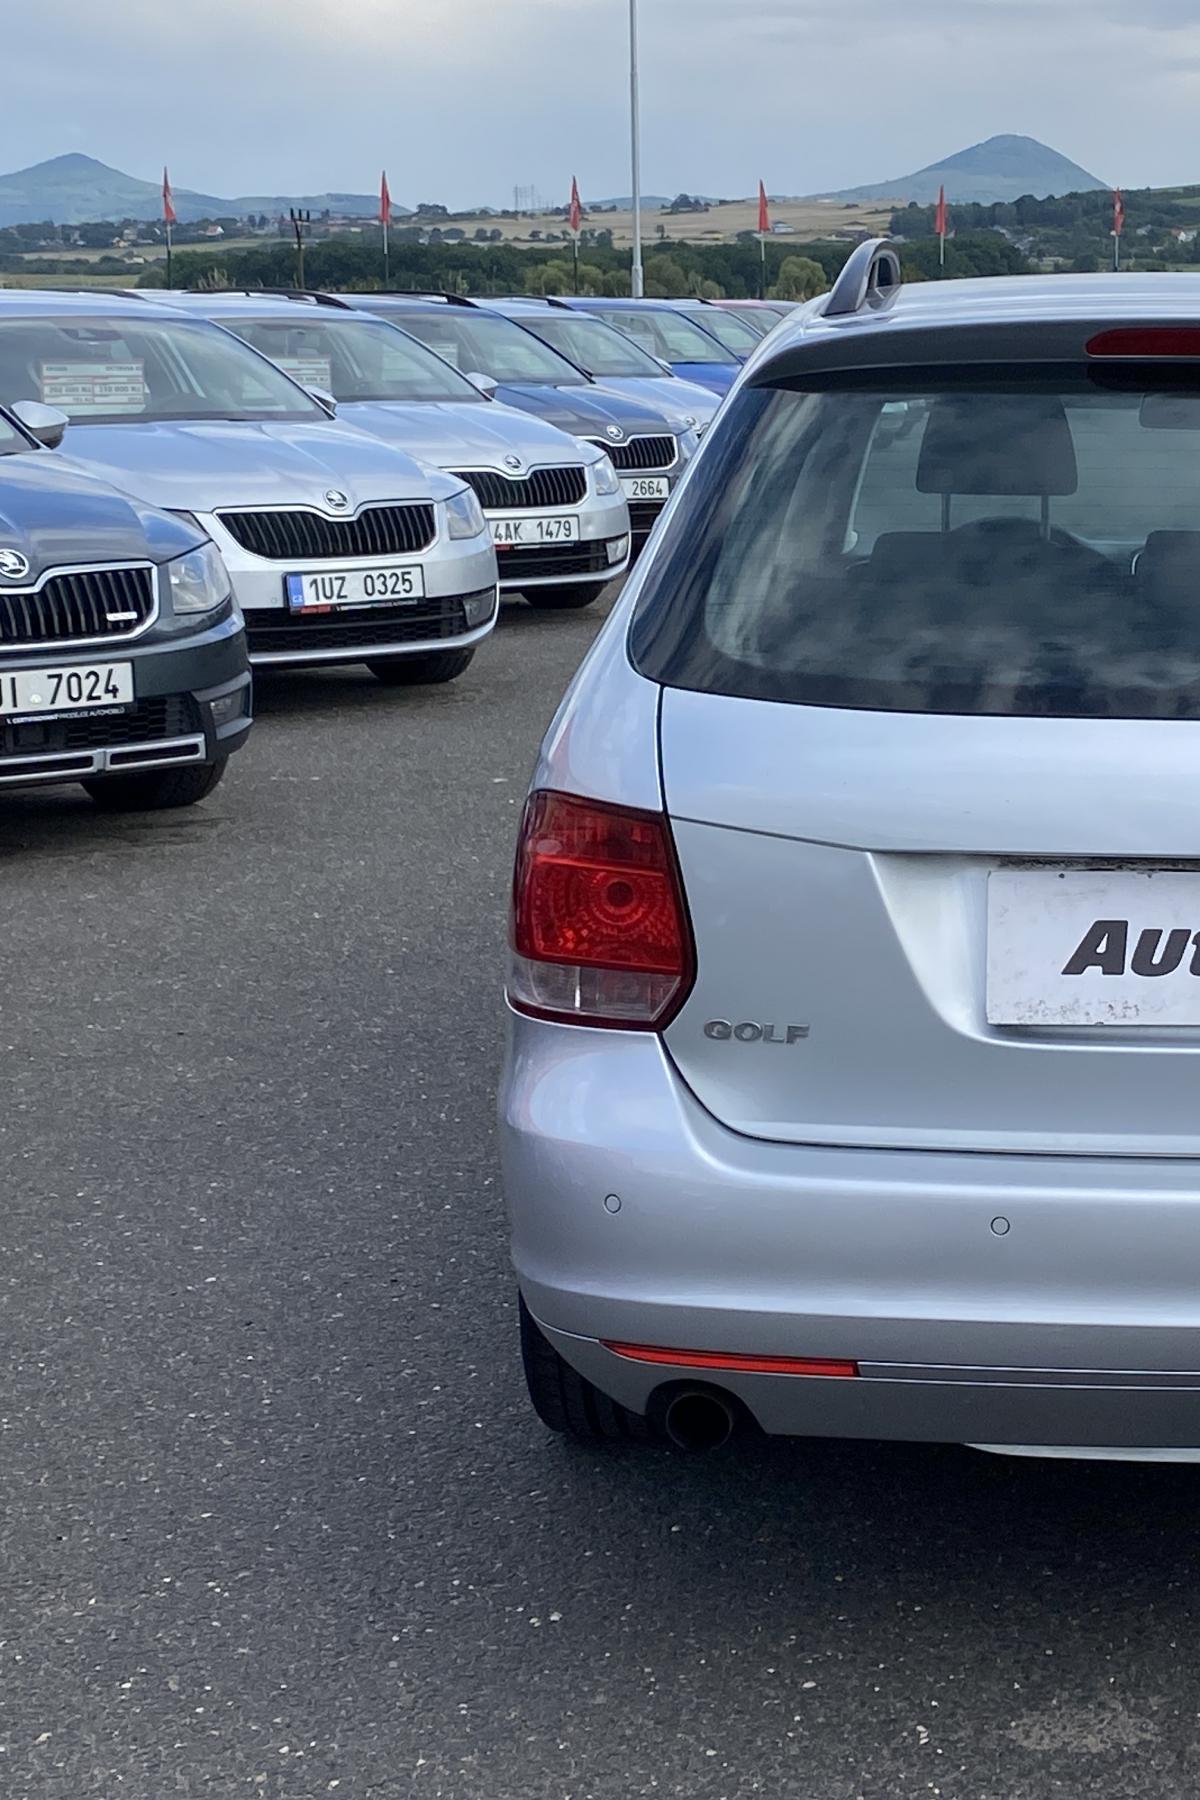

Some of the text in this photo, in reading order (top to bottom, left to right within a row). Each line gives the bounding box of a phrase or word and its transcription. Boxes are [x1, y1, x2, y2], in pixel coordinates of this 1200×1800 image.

[632, 481, 663, 496] 2664
[494, 521, 572, 542] 4AK 1479
[309, 571, 413, 602] 1UZ 0325
[47, 668, 120, 706] 7024
[703, 1018, 811, 1045] GOLF
